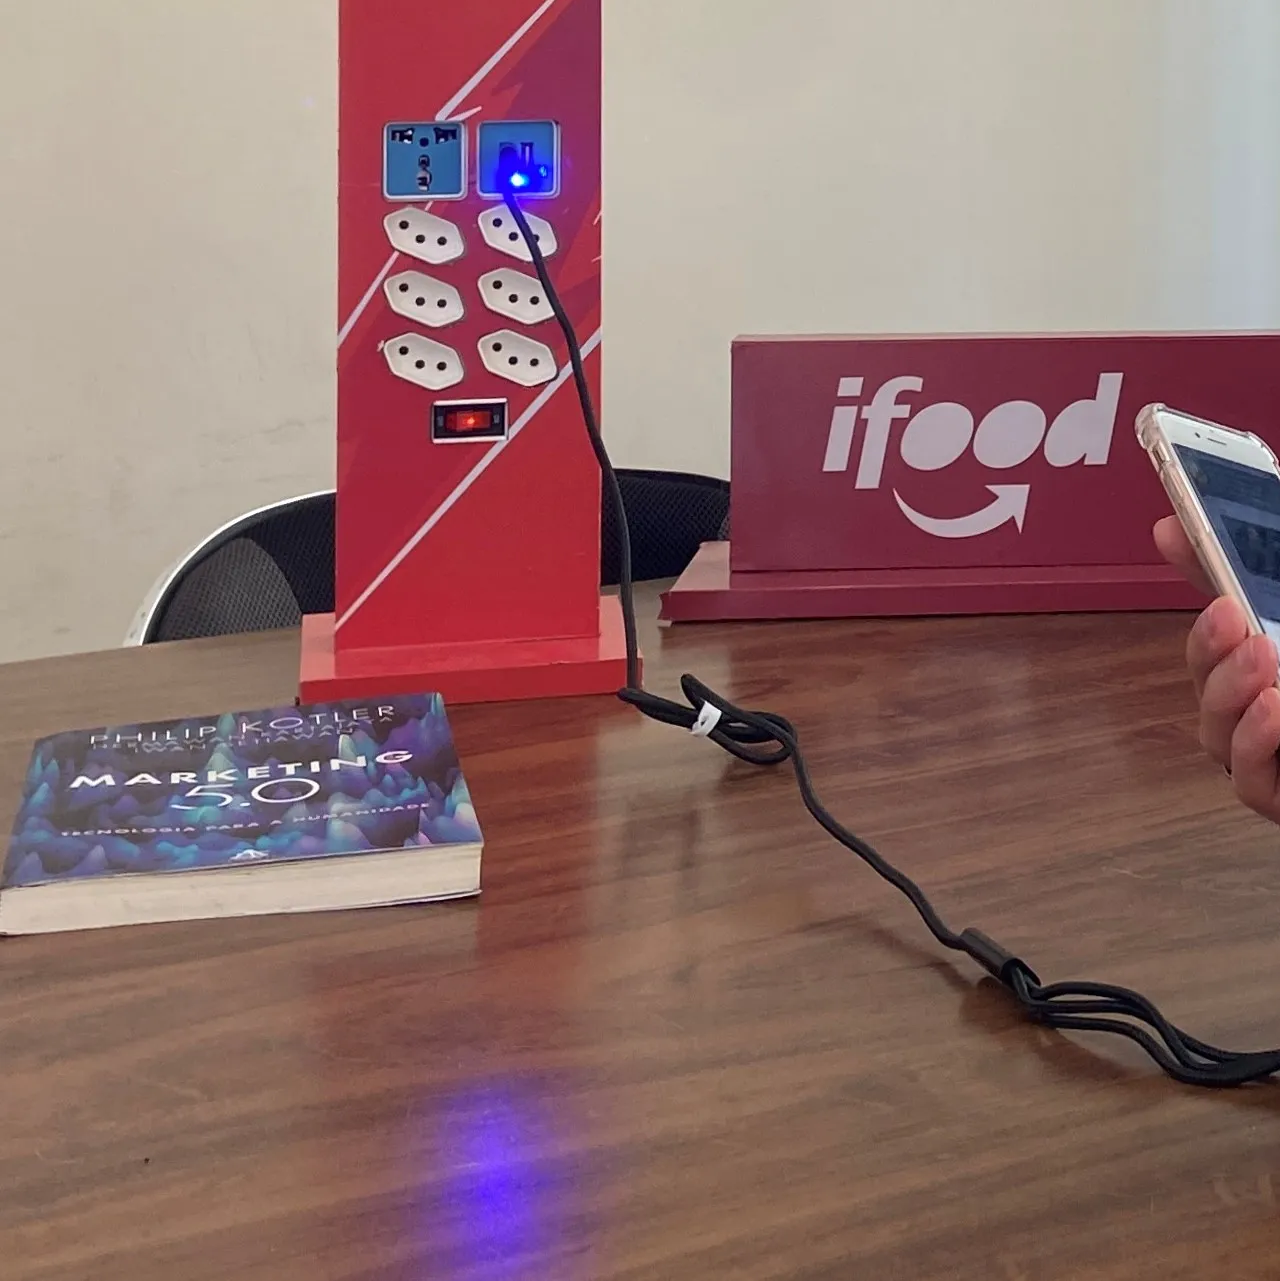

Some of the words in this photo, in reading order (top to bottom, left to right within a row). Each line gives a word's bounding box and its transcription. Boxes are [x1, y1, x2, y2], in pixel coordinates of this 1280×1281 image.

[90, 726, 217, 745] PHILIP
[242, 705, 395, 733] KOTLER
[69, 750, 414, 789] MARKETING
[171, 777, 321, 811] 5.0
[61, 825, 196, 837] TECNOLOGIA
[206, 821, 260, 832] PARA
[293, 802, 431, 823] HUMANIDADE
